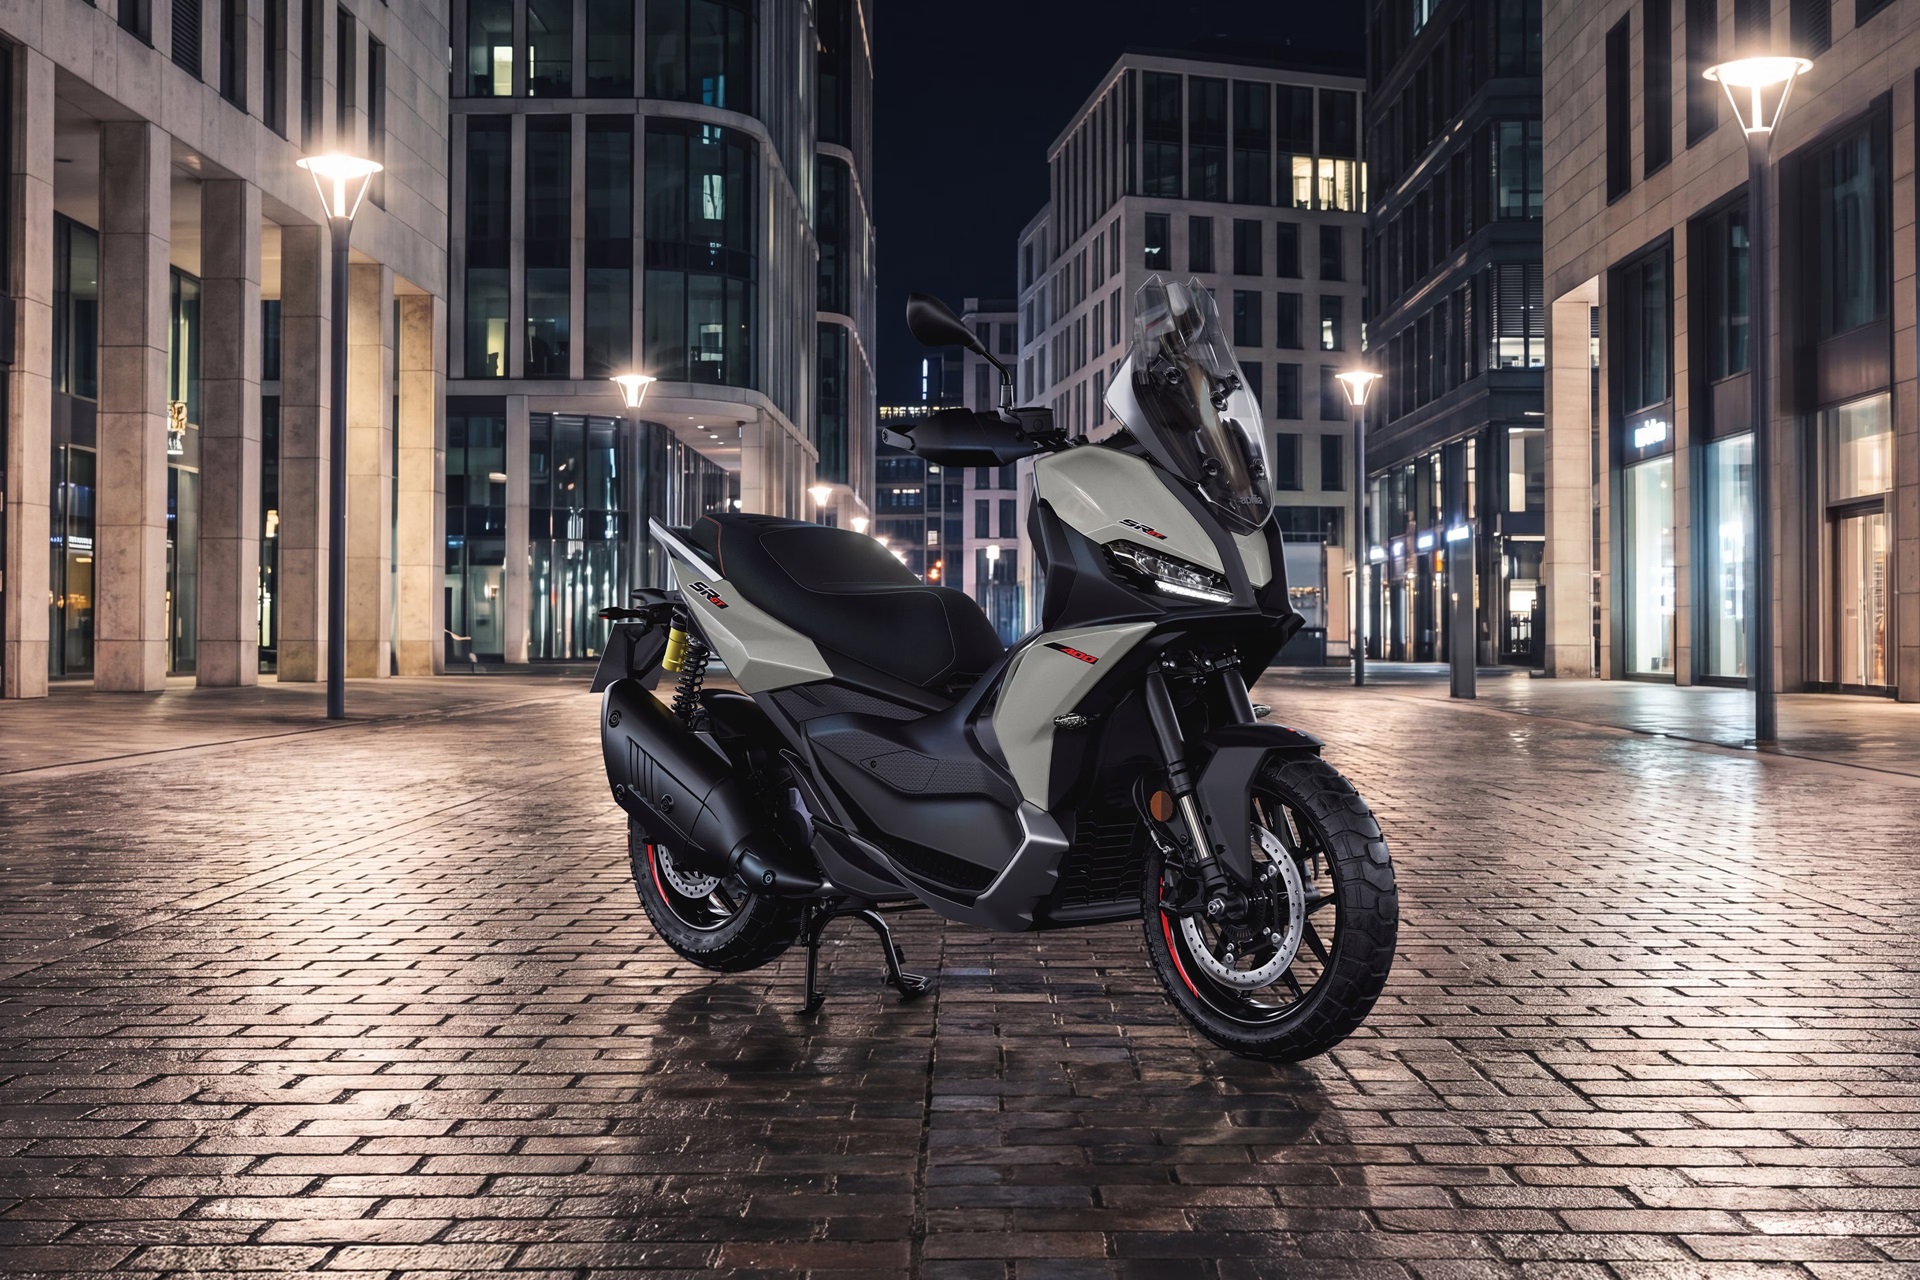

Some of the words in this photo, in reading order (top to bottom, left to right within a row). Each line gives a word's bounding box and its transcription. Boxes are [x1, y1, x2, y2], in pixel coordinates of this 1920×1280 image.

[1118, 518, 1155, 533] SR
[688, 581, 721, 601] SR
[1060, 647, 1098, 664] 400
